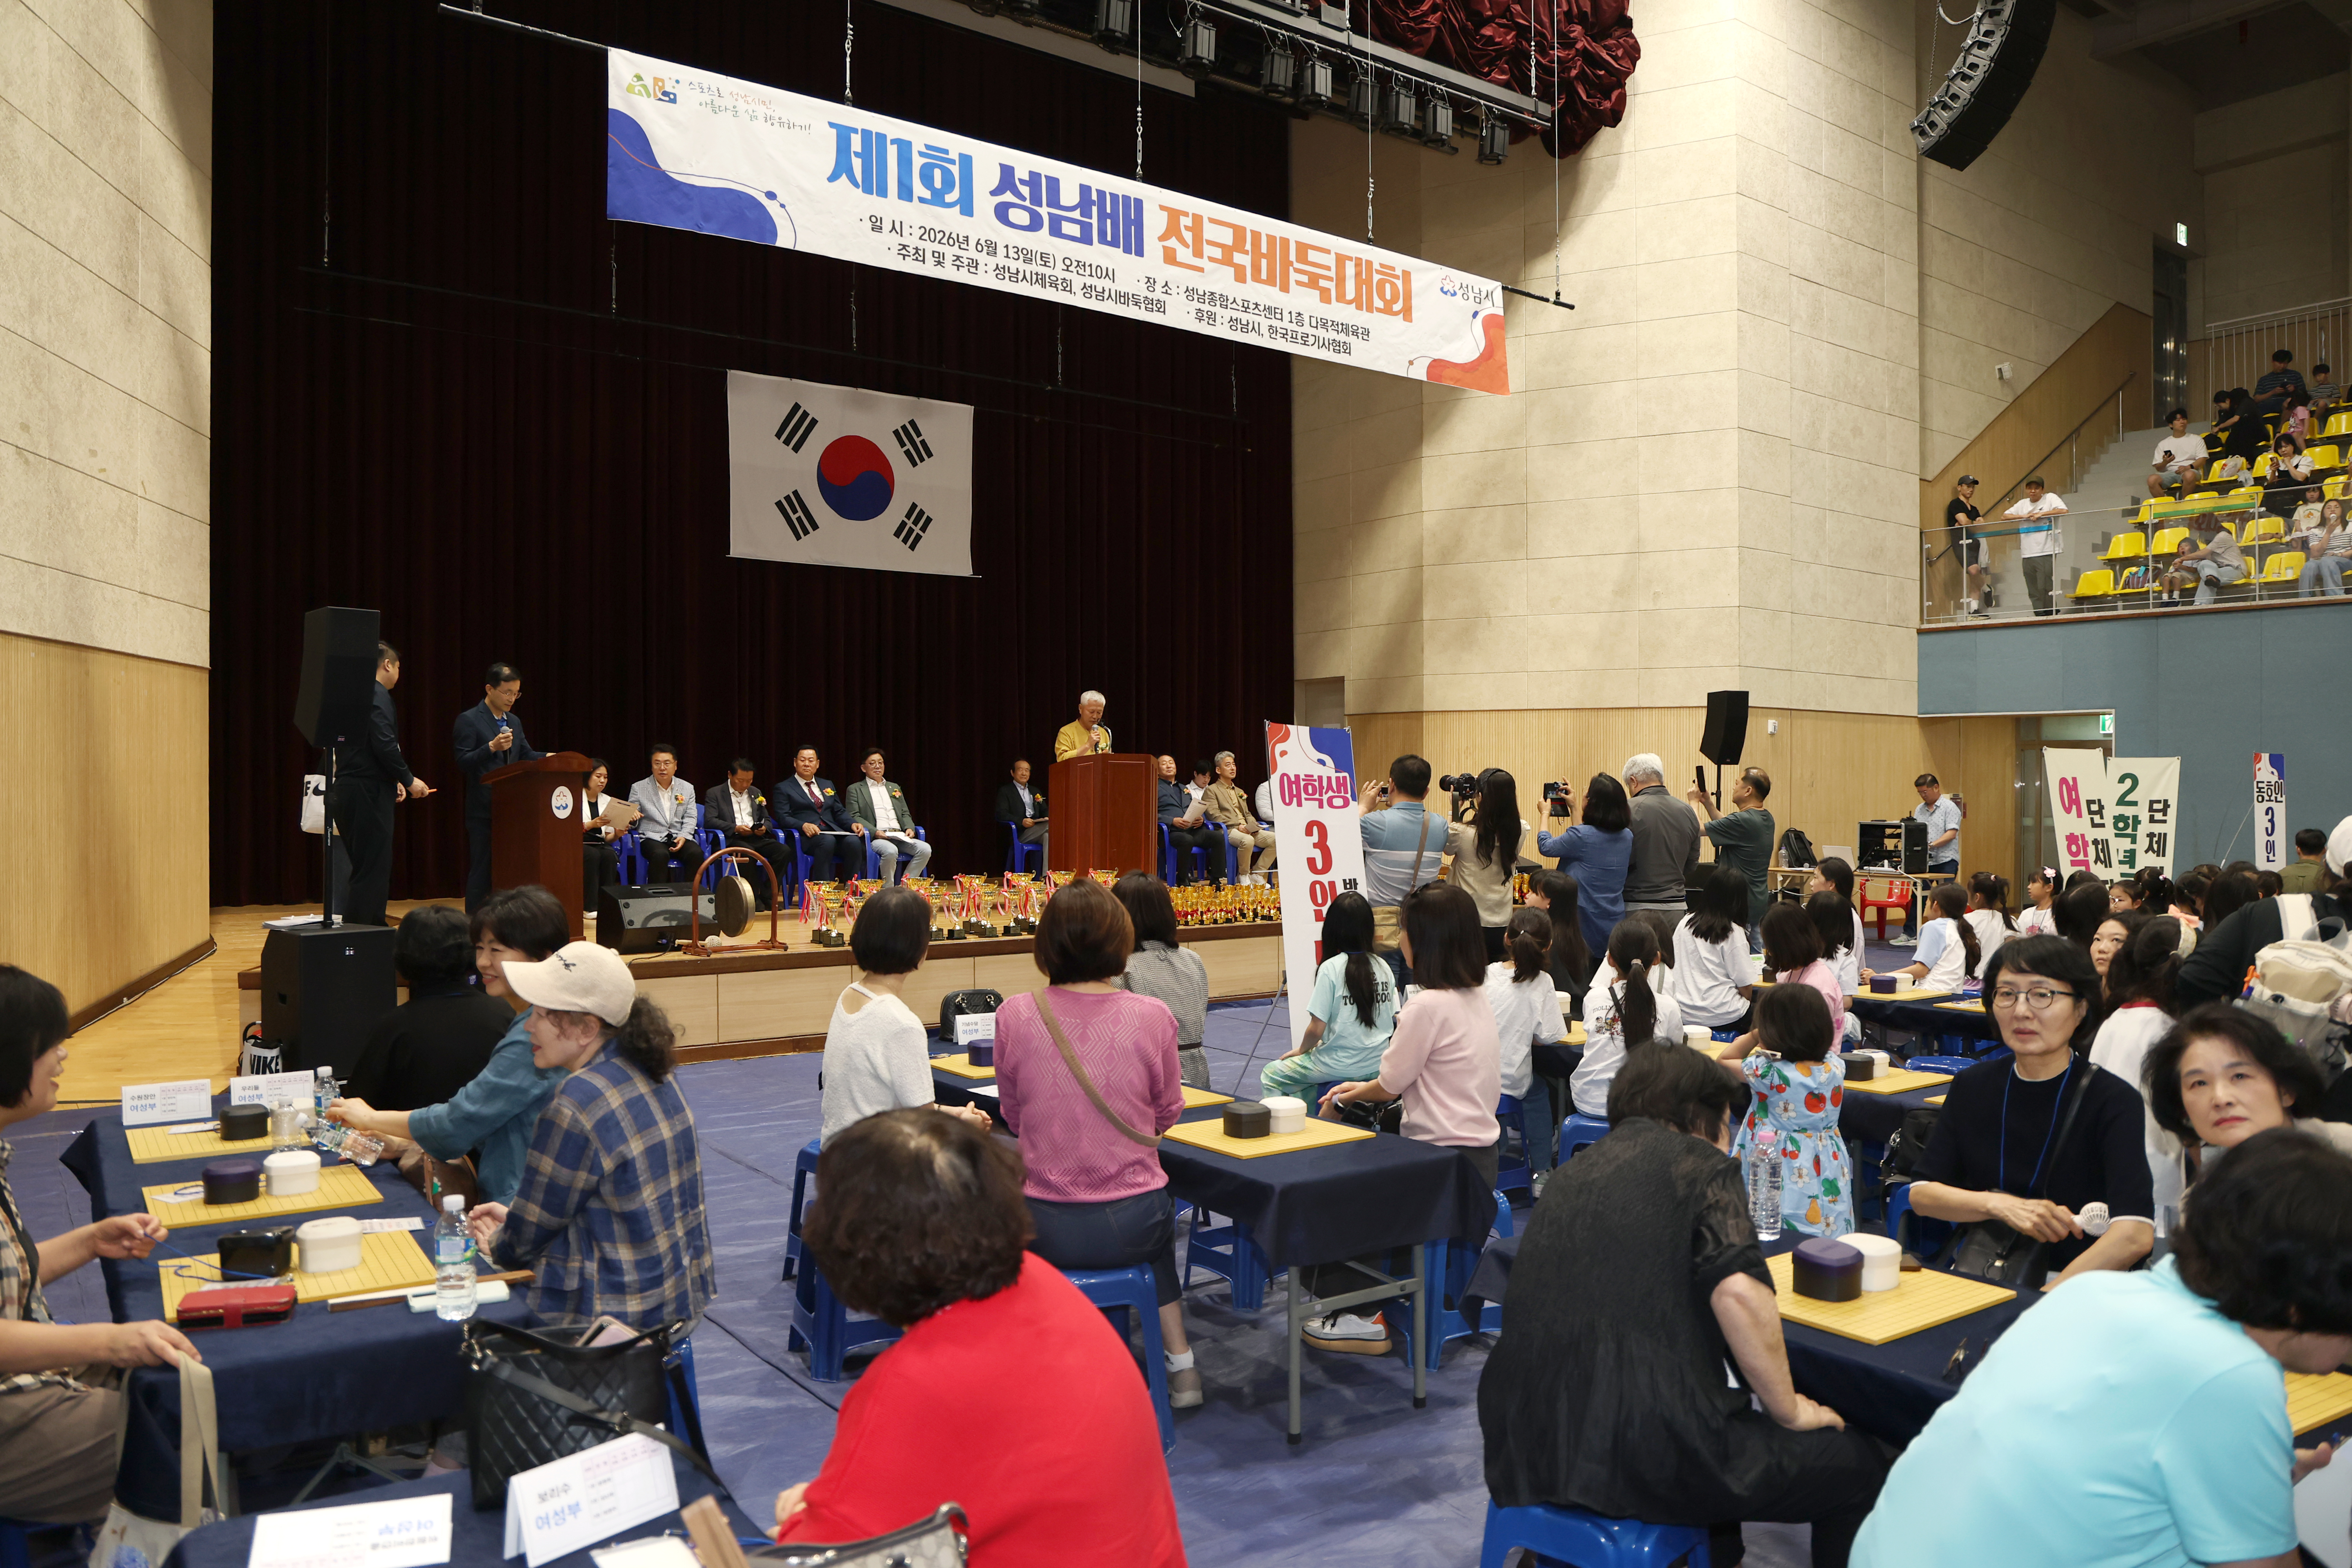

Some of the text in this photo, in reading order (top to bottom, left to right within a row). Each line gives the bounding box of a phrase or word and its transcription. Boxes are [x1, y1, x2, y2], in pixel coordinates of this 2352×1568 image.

[689, 81, 775, 112] 스포츠로 성남시민,
[699, 99, 811, 134] 아름다운 삶 향유하기!
[827, 121, 1412, 323] 제1회 성남배 전국바둑대회
[869, 215, 883, 233] 일
[889, 220, 903, 237] 시
[918, 225, 969, 251] 2026년
[975, 238, 998, 257] 6월
[1004, 244, 1056, 270] 13일(토)
[1062, 257, 1115, 283] 오전10시
[897, 243, 926, 265] 주최
[932, 250, 946, 269] 및
[951, 254, 979, 275] 주관
[993, 262, 1076, 297] 성남시체육회,
[1080, 282, 1166, 315] 성남시바둑협회
[1458, 282, 1495, 308] 성남시
[1145, 276, 1157, 293] 장
[1161, 281, 1172, 296] 소
[1184, 285, 1284, 323] 성남종합스포츠센터
[1288, 310, 1305, 327] 1층
[1309, 315, 1370, 342] 다목적체육관
[1194, 307, 1217, 326] 후원
[1227, 317, 1264, 339] 성남시,
[1268, 324, 1352, 356] 한국프로기사협회
[1279, 772, 1351, 809] 여학생
[2256, 780, 2283, 803] 동호인
[130, 1103, 157, 1112] 여성부
[238, 1093, 264, 1103] 여성부
